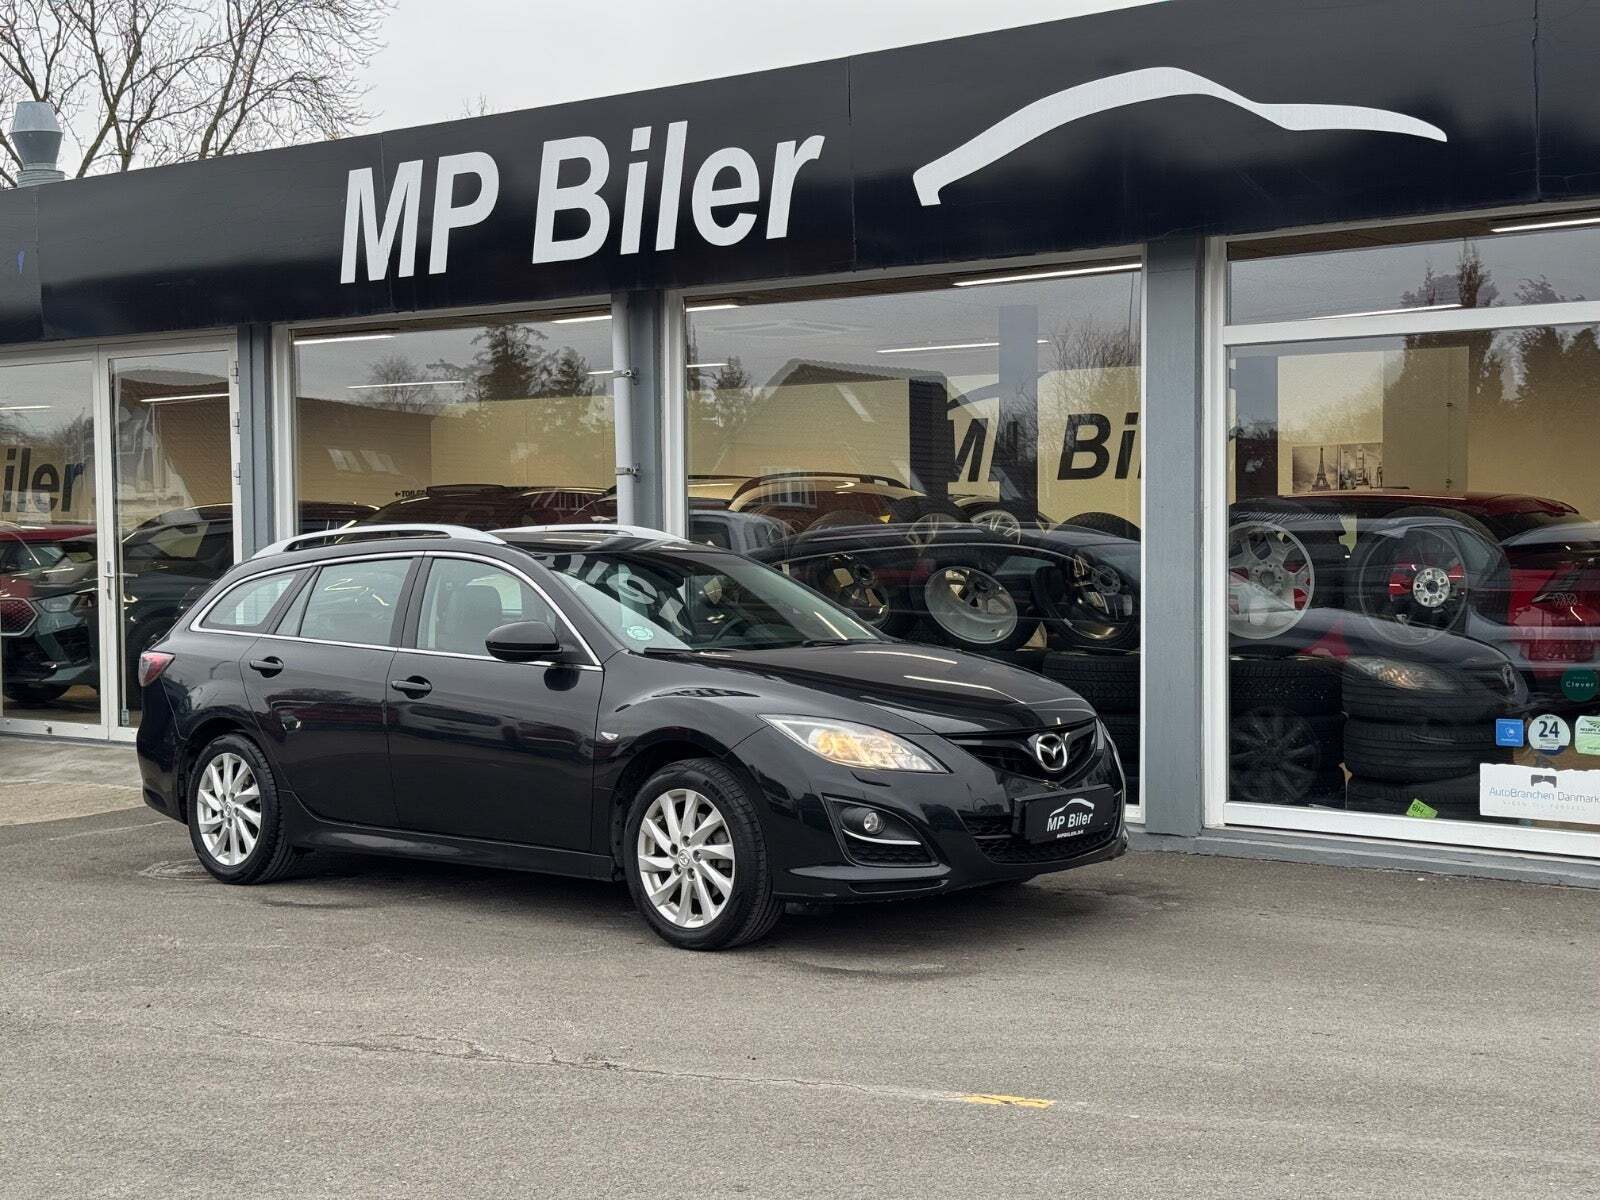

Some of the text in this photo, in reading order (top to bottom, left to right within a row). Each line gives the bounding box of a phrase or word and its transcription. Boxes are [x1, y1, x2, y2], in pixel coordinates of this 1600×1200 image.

[340, 120, 825, 284] MP Biler
[1057, 412, 1141, 481] Bi
[1538, 720, 1560, 738] 24
[1488, 786, 1555, 801] AutoBranchen
[1046, 812, 1093, 832] MP Biler
